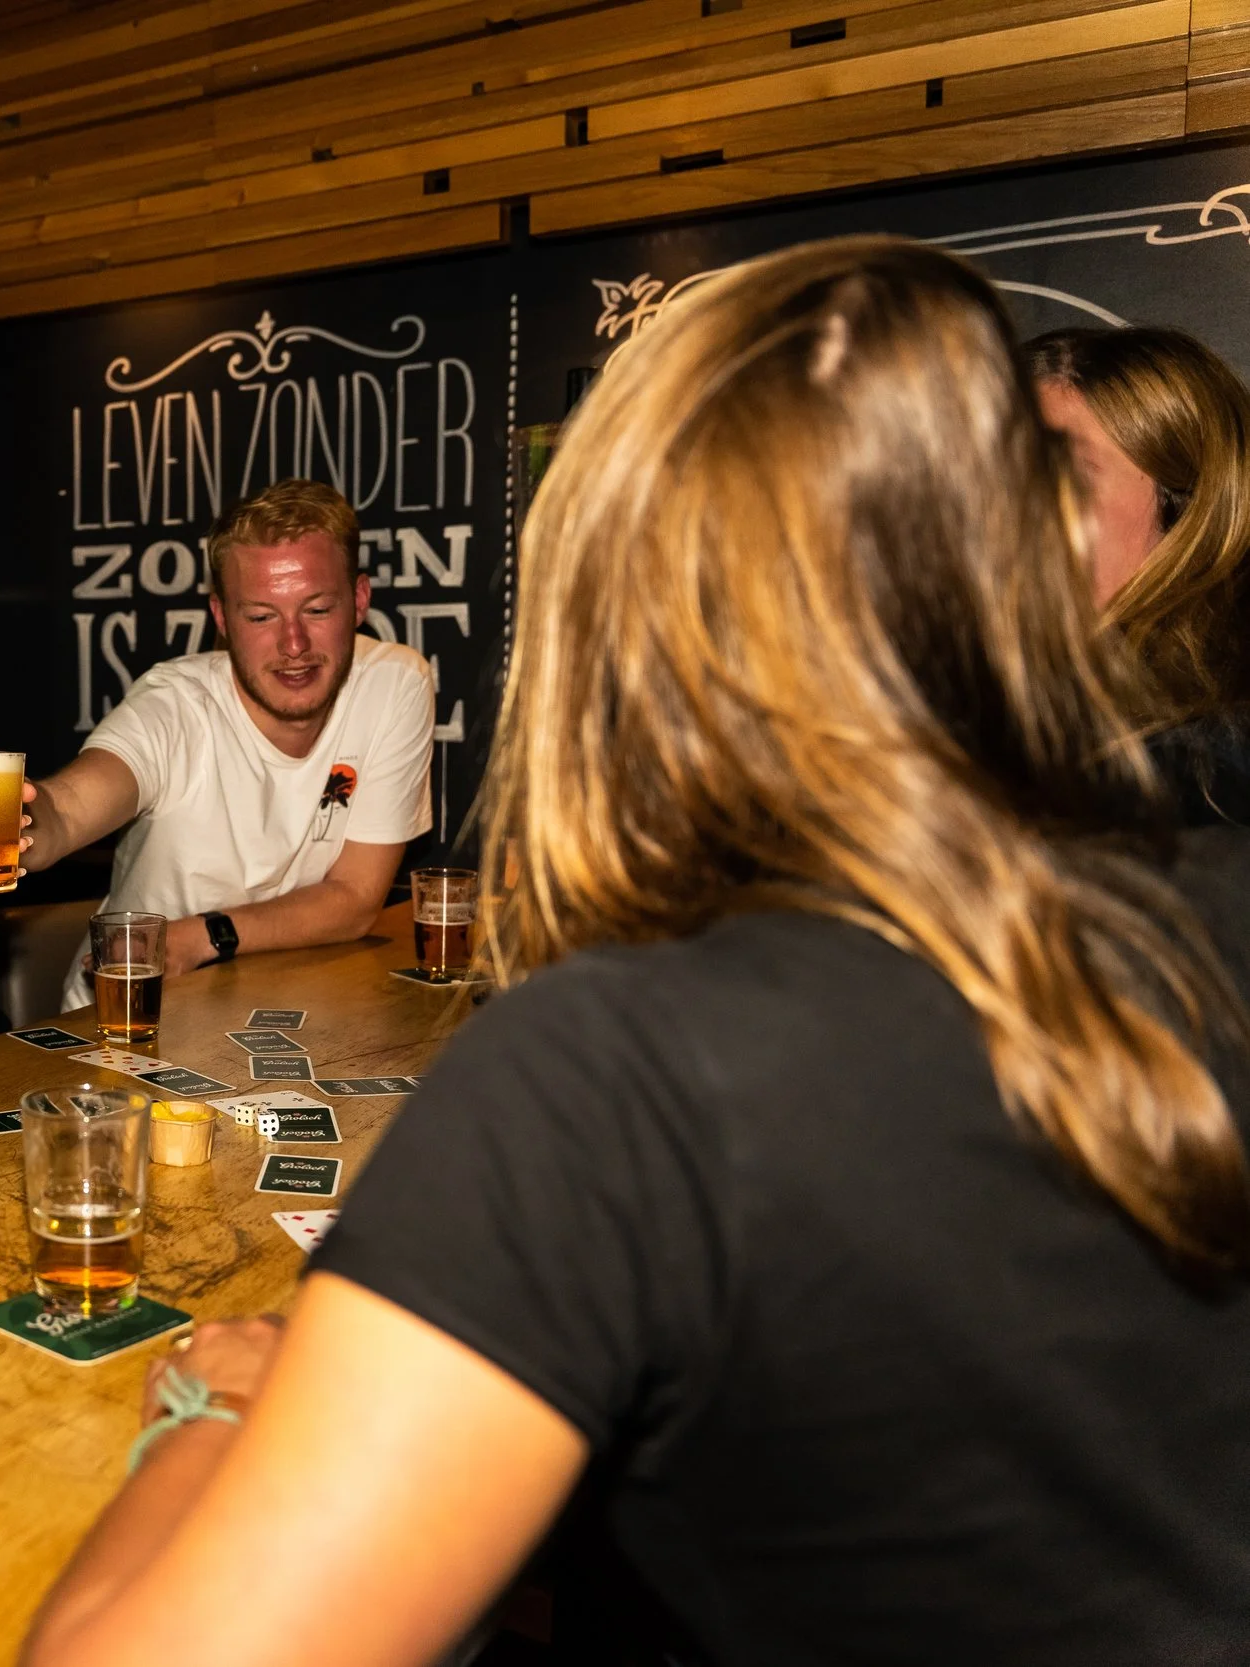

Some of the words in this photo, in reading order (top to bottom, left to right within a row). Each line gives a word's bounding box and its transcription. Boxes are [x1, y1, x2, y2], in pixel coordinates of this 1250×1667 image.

[72, 389, 222, 531] LEVEN
[239, 358, 475, 513] ZONDER
[72, 523, 473, 599] ZOEN
[72, 610, 138, 732] IS
[279, 1113, 323, 1122] Grolsch
[279, 1161, 328, 1172] Grolsch
